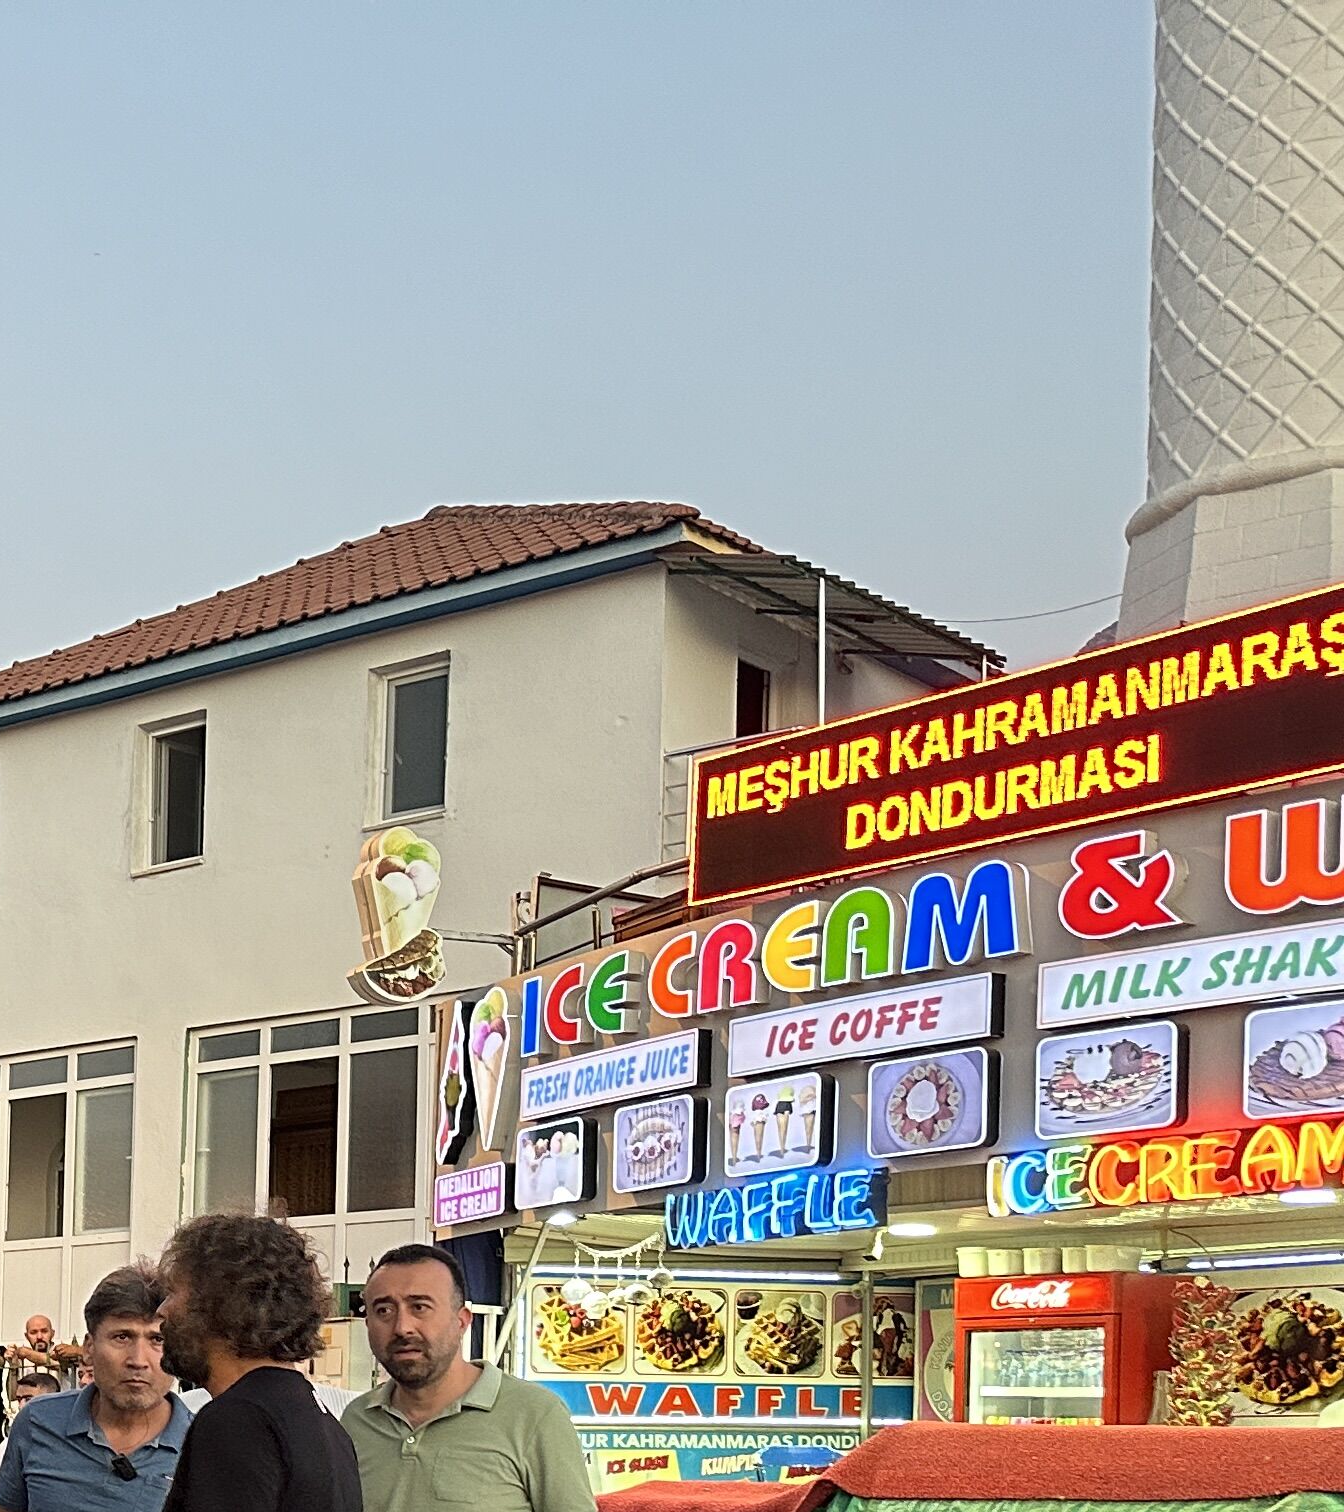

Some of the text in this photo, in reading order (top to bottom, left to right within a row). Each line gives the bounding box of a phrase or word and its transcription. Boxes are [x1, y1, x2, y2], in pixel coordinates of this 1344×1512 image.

[706, 612, 1344, 819] MEŞHUR KAHRAMANMARAŞ
[844, 734, 1162, 852] DONDURMASI
[520, 950, 629, 1058] ICE
[648, 859, 1020, 1018] CREAM
[1058, 830, 1184, 940] &
[1061, 935, 1344, 1011] MILK SHAK
[765, 996, 943, 1058] ICE COFFE
[527, 1044, 690, 1109] FRESH ORANGE JUICE
[439, 1166, 499, 1200] MEDALLION
[440, 1190, 498, 1221] ICE CREAM
[665, 1170, 876, 1248] WAFFLE
[586, 1383, 862, 1418] WAFFLE
